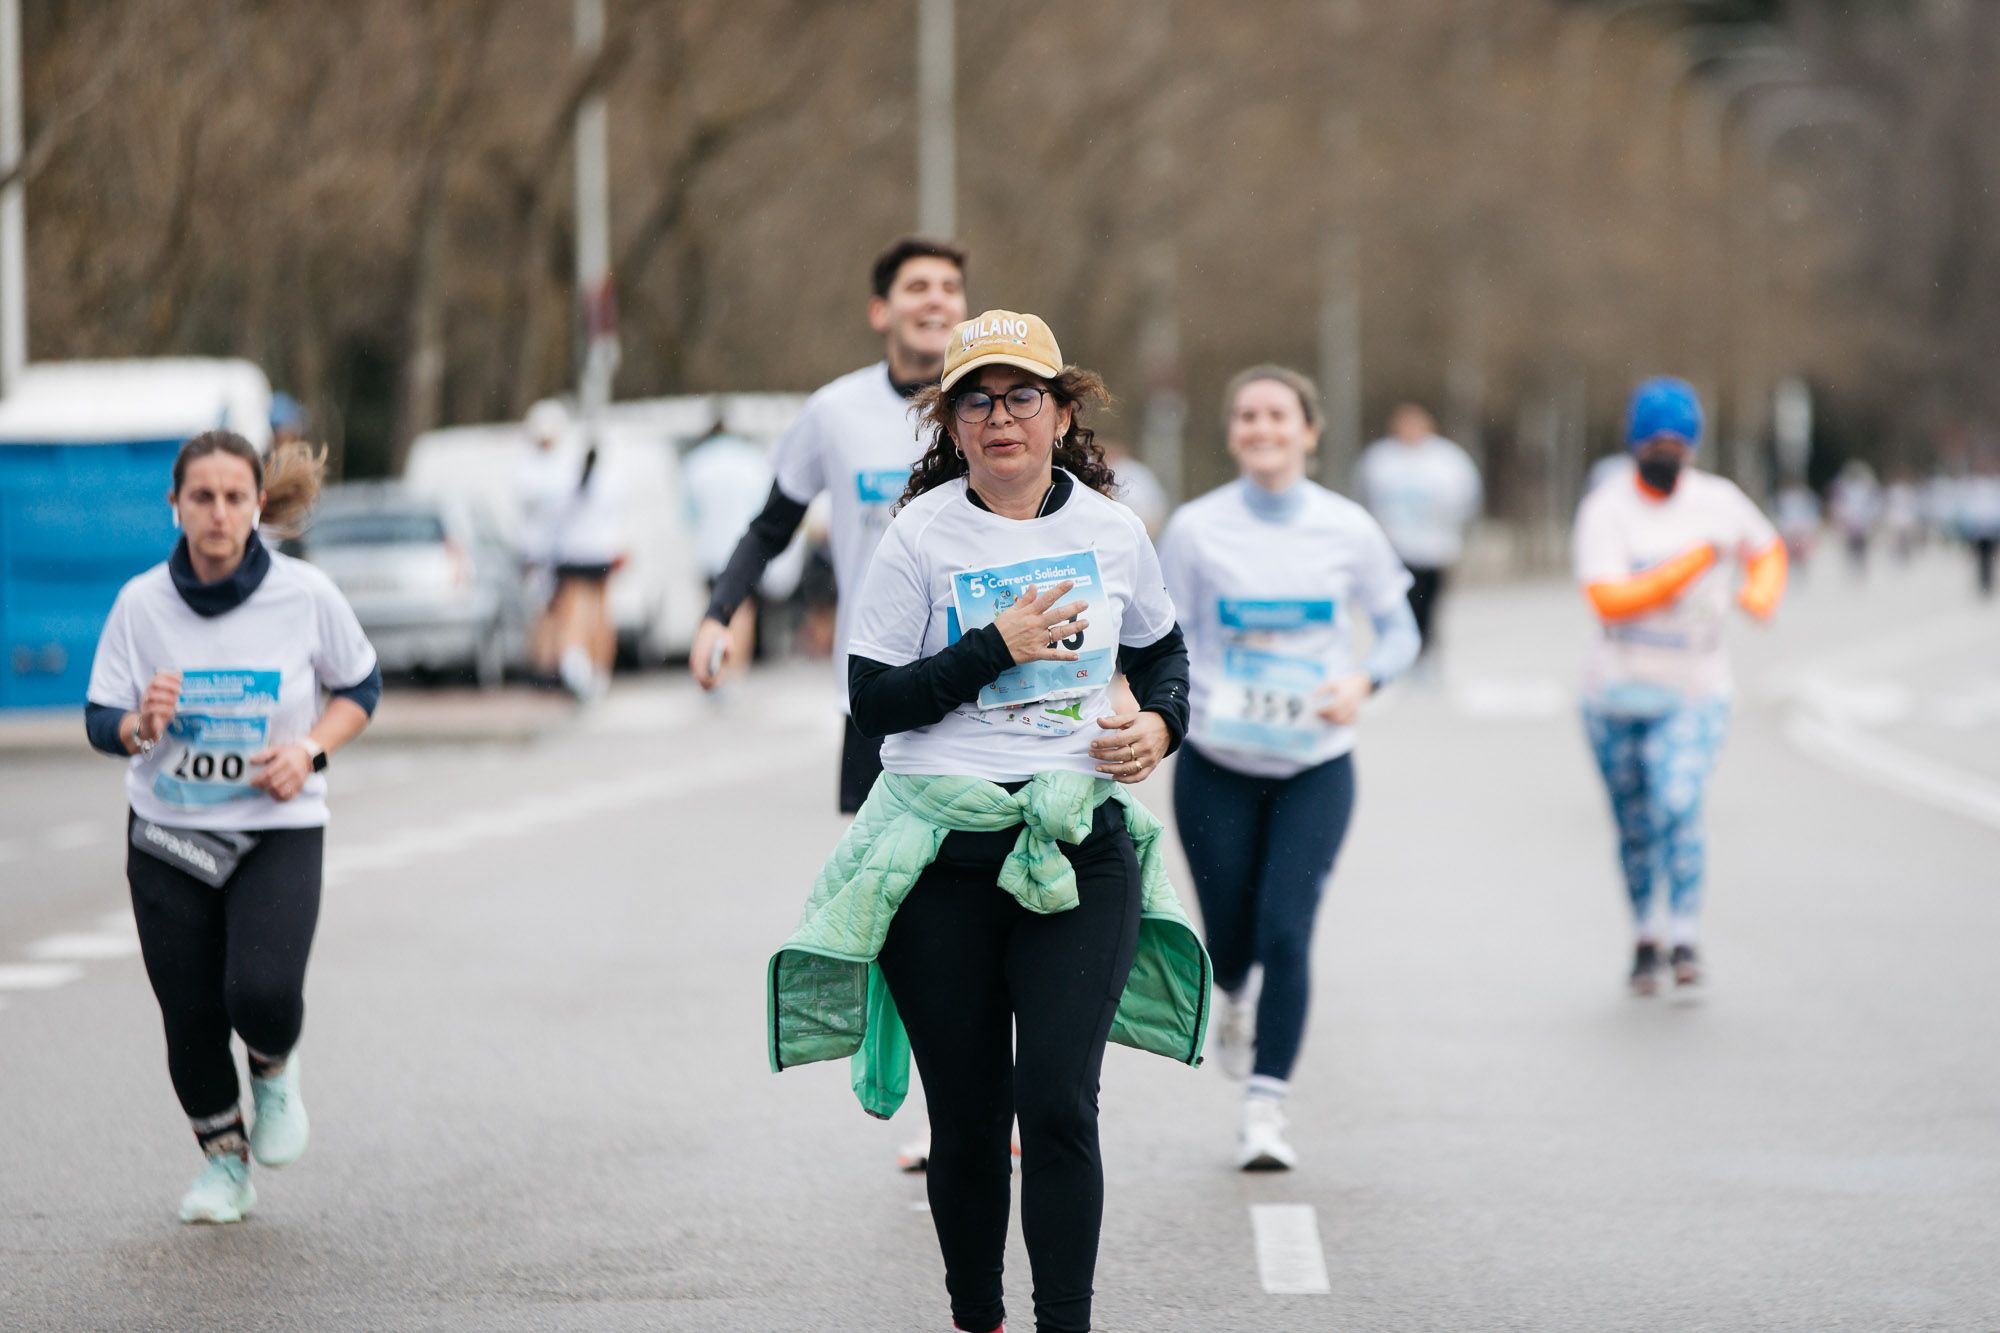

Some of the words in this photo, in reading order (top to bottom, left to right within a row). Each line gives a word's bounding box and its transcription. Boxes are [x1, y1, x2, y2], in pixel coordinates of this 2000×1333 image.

[962, 319, 1028, 347] MILANO
[988, 574, 1033, 589] Carrera
[1034, 565, 1077, 580] Solidaria
